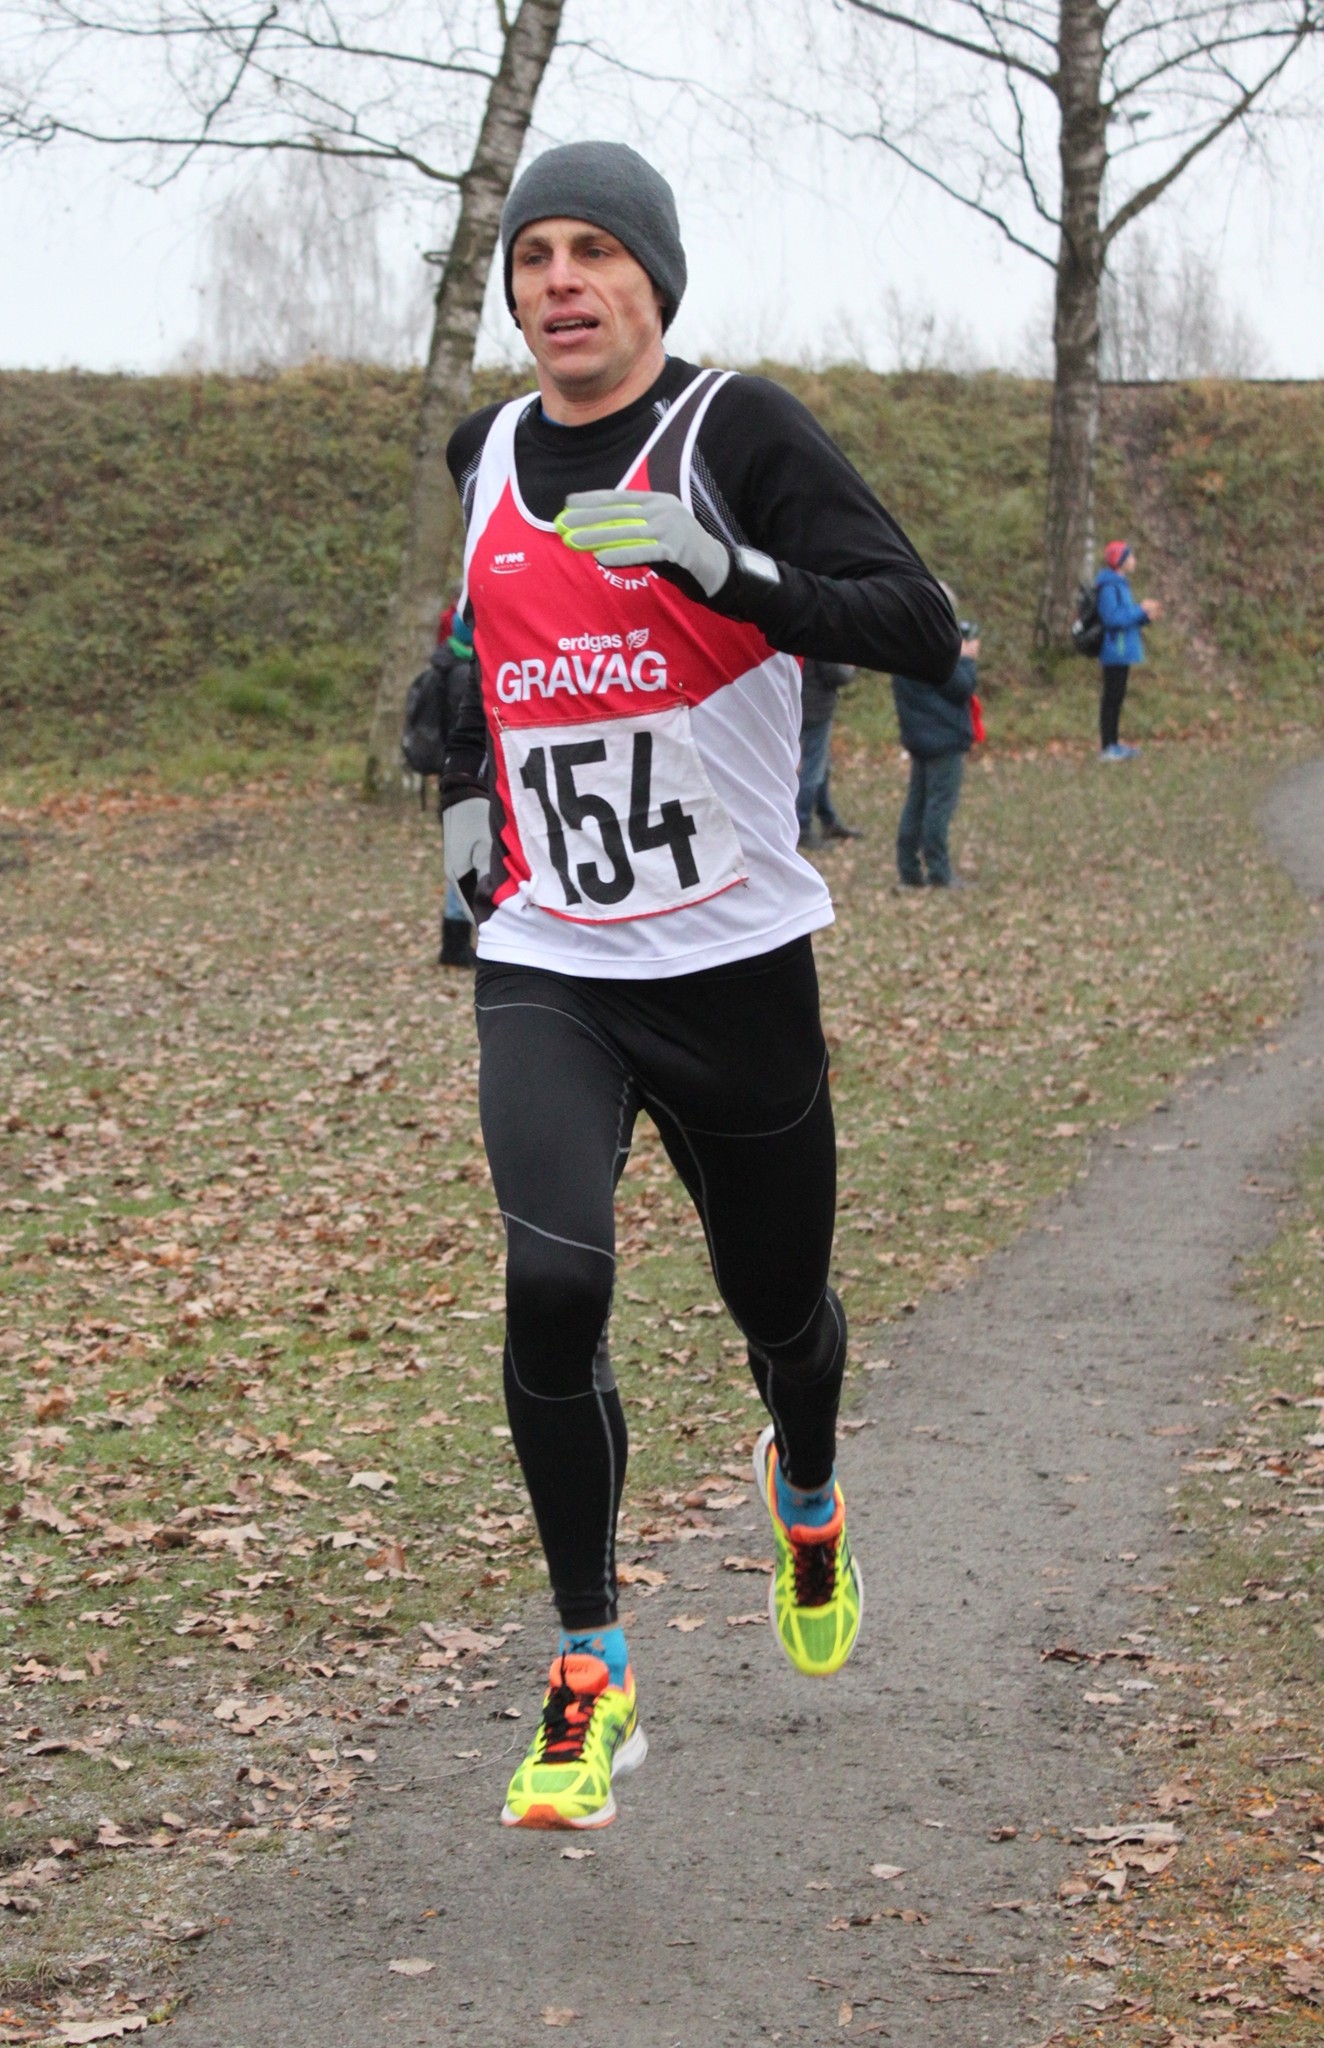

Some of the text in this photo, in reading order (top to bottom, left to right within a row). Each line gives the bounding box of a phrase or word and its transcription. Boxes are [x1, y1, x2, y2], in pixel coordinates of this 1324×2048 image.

[557, 632, 622, 653] erdgas
[496, 650, 667, 704] GRAVAG
[519, 731, 700, 906] 154
